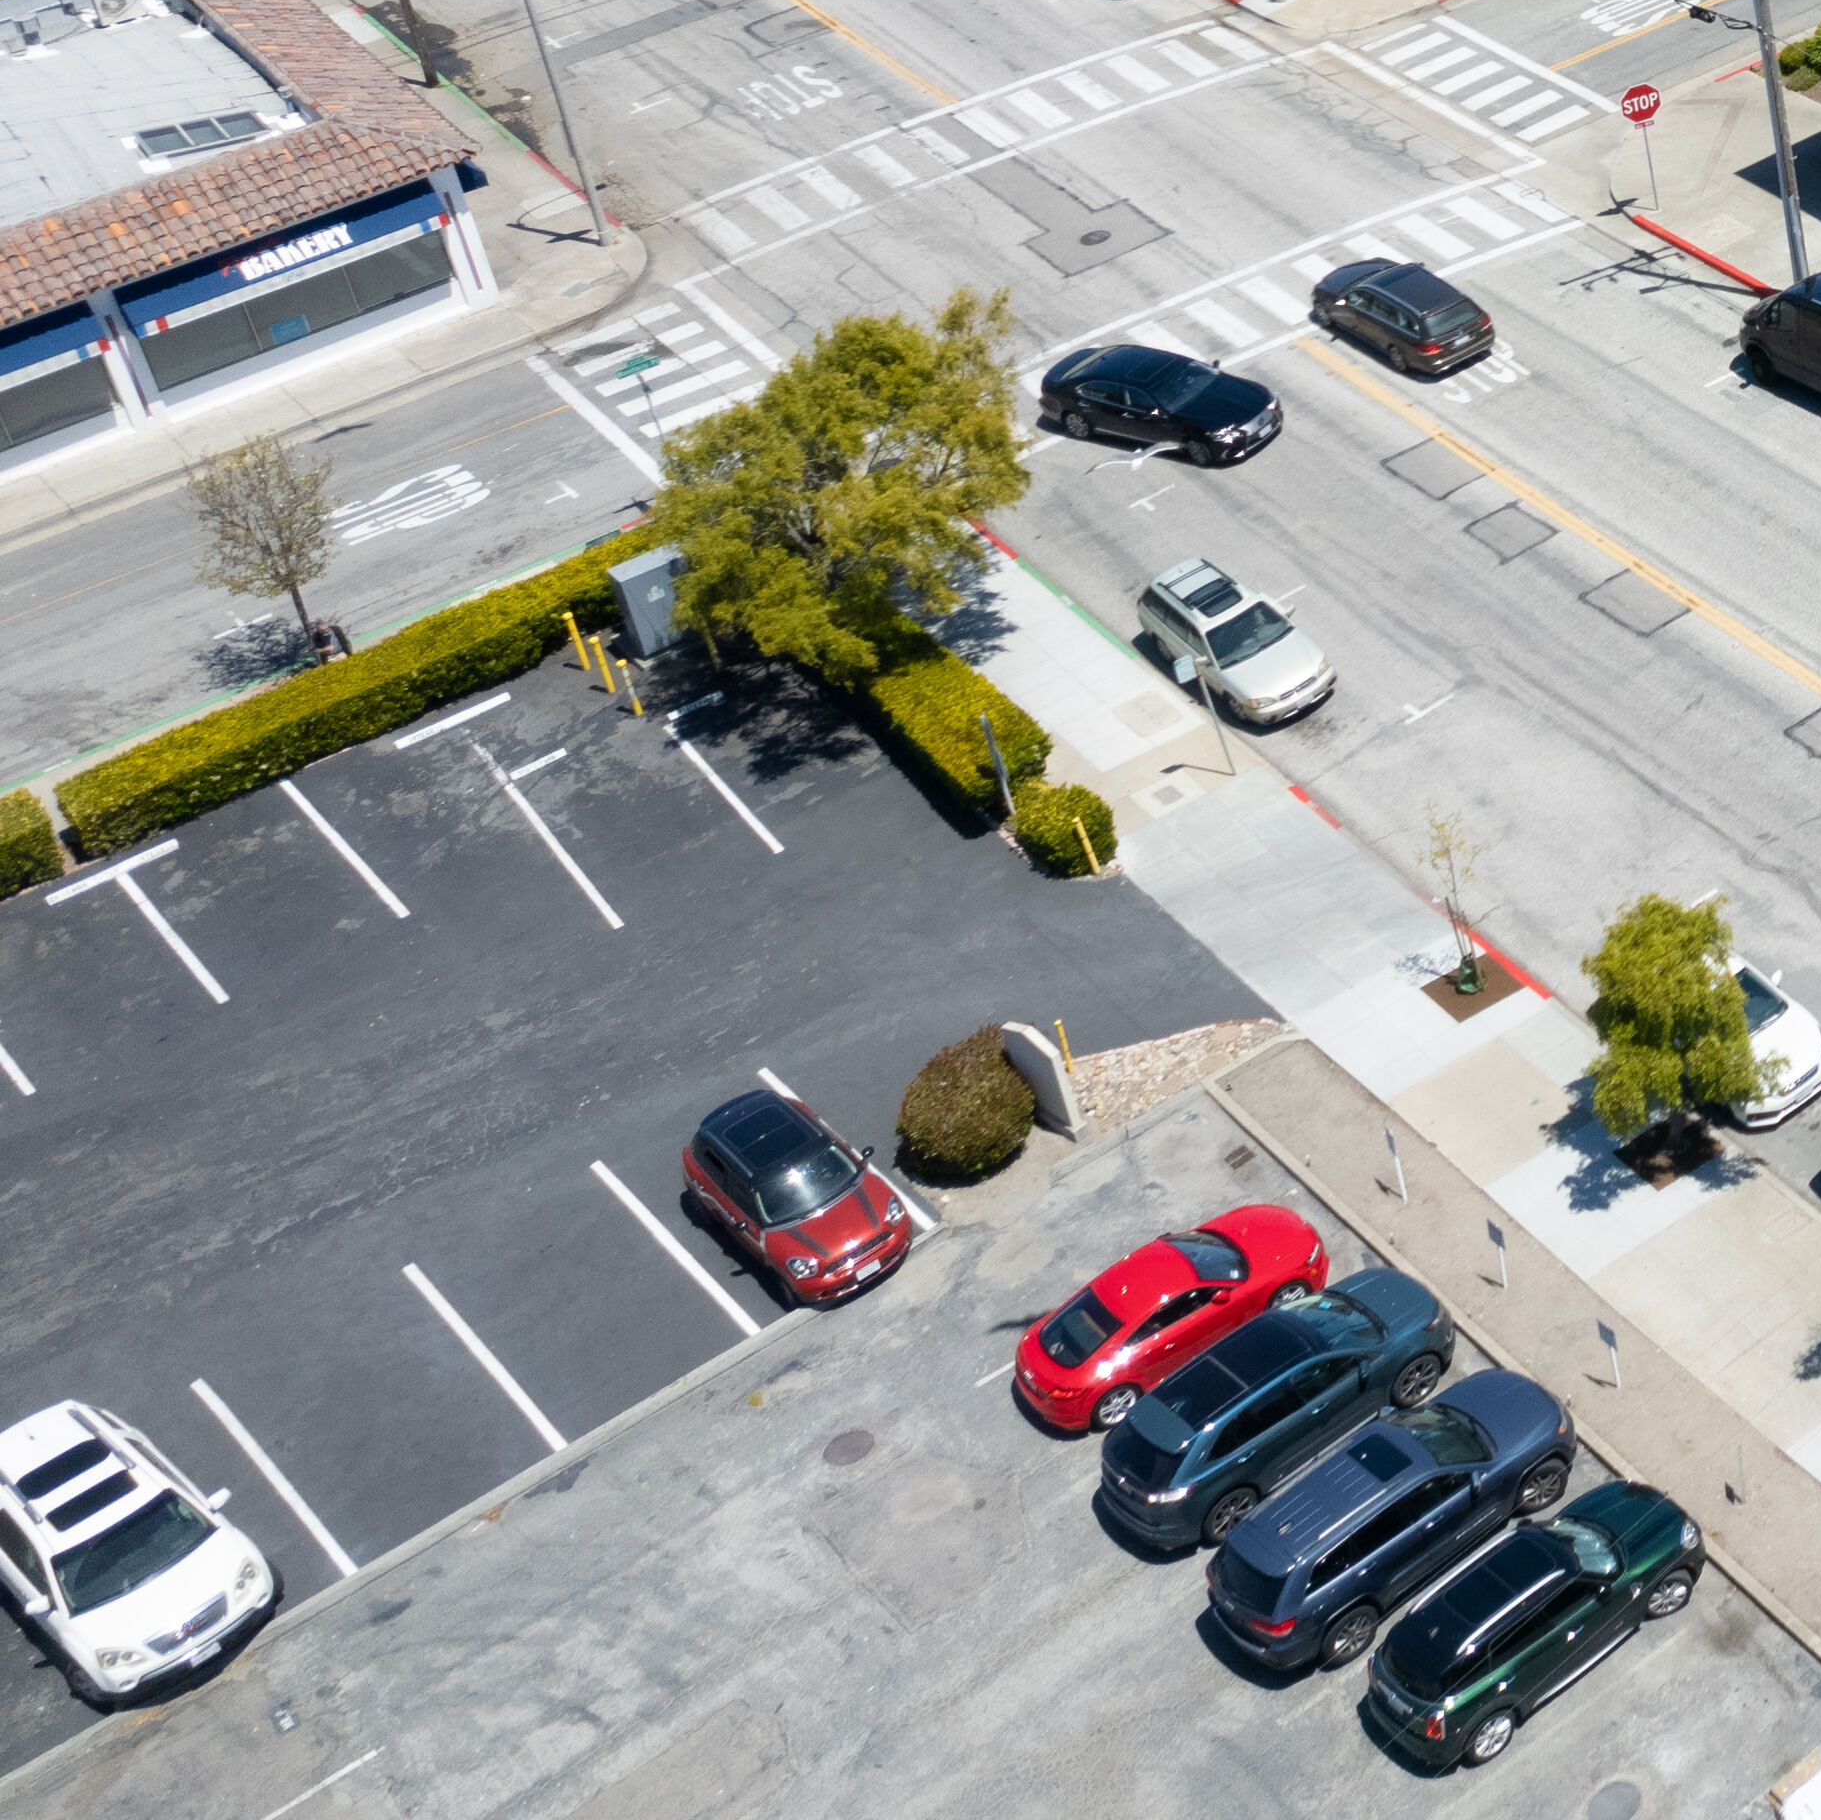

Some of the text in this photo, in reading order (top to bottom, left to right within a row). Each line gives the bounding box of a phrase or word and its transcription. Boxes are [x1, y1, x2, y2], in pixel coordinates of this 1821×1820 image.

[736, 65, 844, 120] STOP
[1623, 92, 1658, 115] STOP
[241, 222, 354, 281] BAKERY
